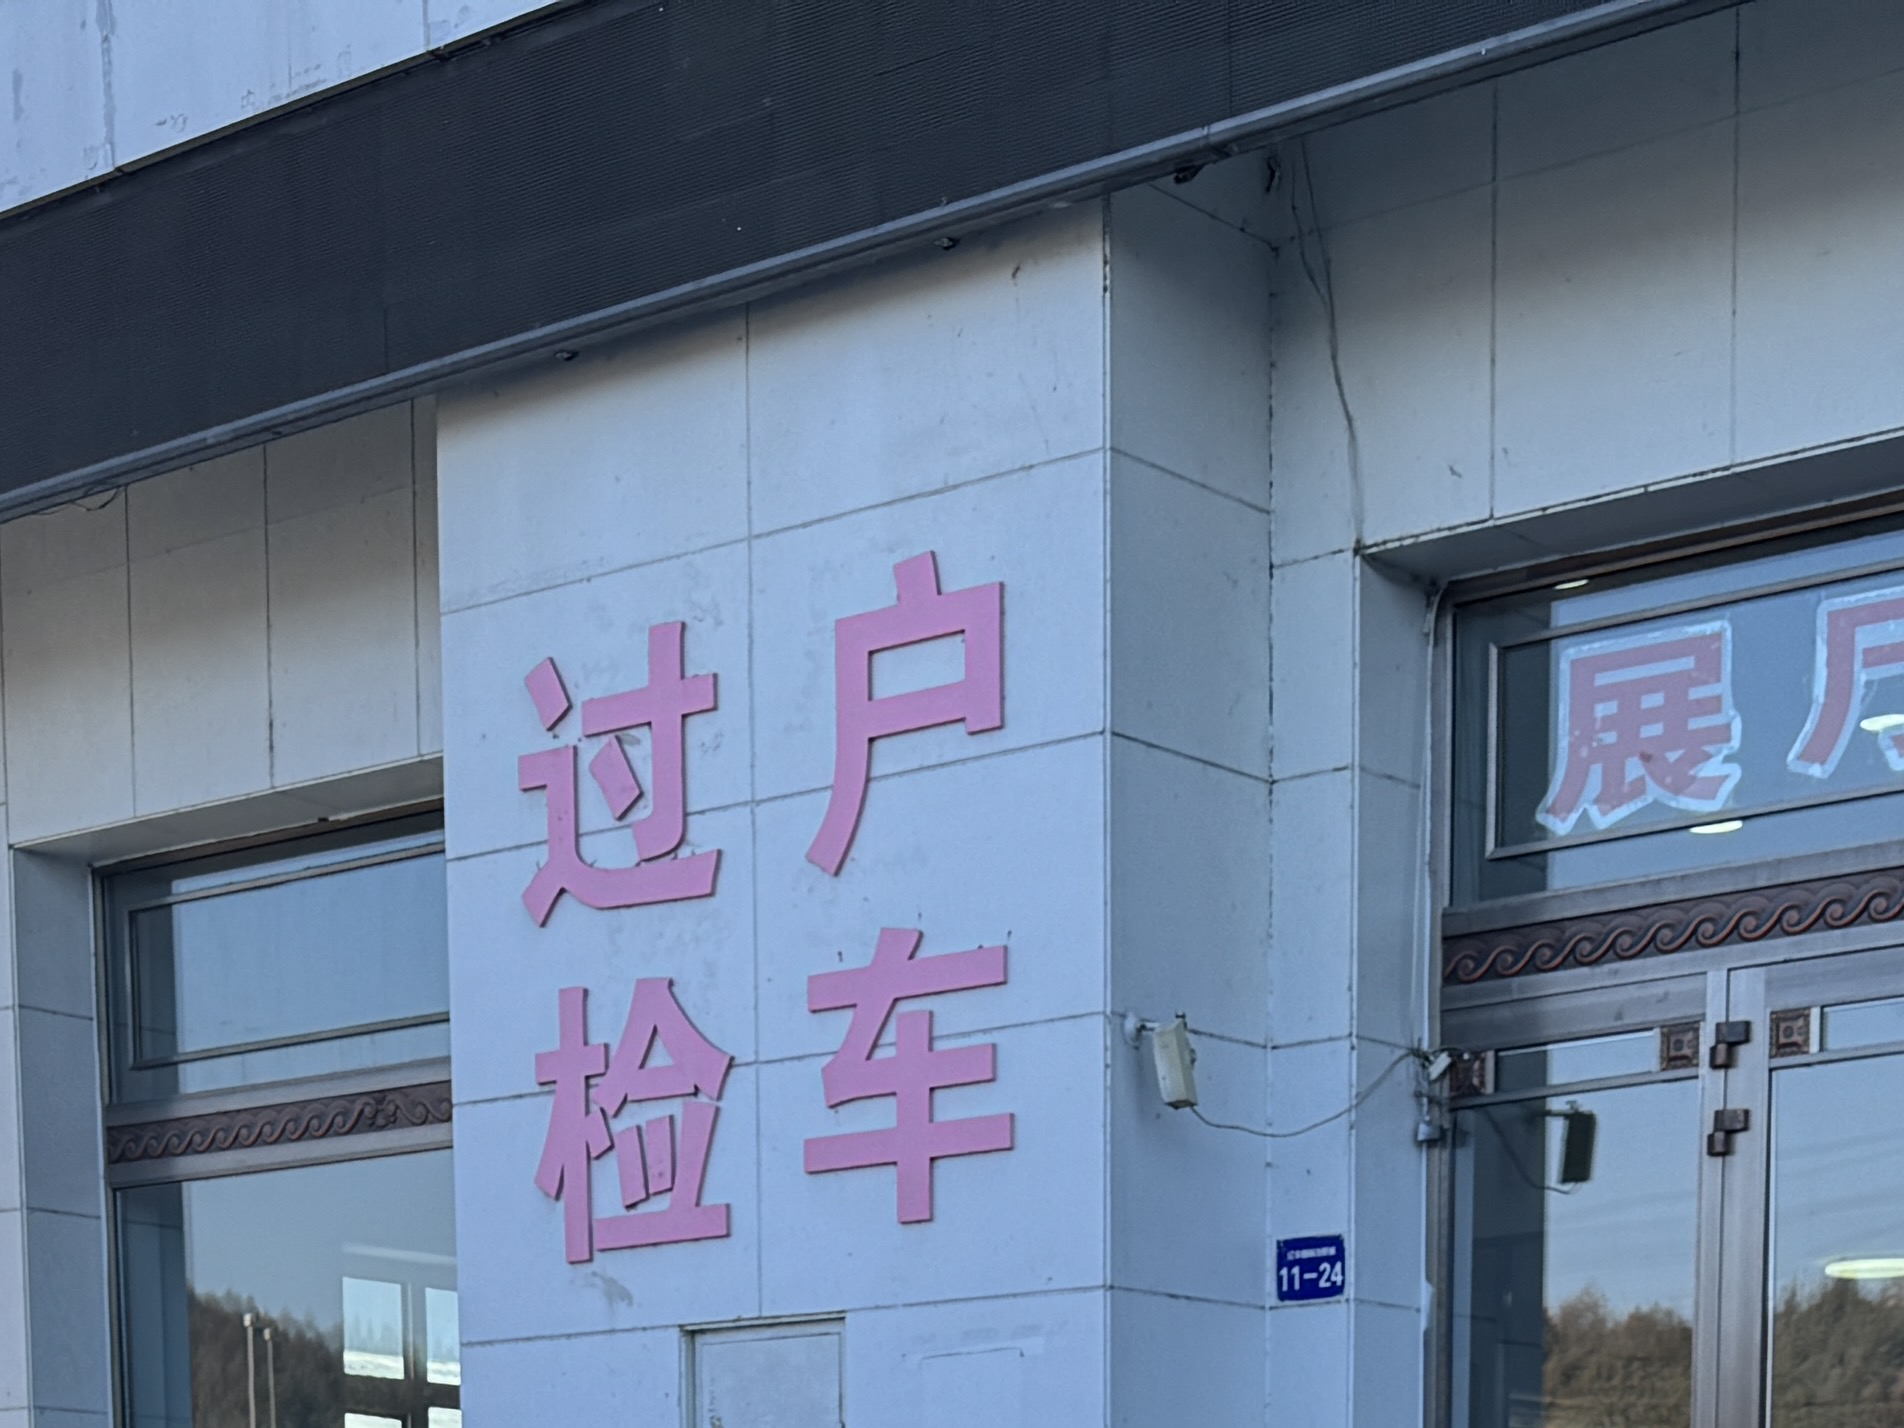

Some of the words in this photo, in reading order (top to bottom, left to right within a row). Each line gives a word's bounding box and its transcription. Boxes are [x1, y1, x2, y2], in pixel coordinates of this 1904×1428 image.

[518, 550, 1005, 927] 过户
[533, 927, 1015, 1263] 检车
[1279, 1260, 1343, 1292] 11-24
